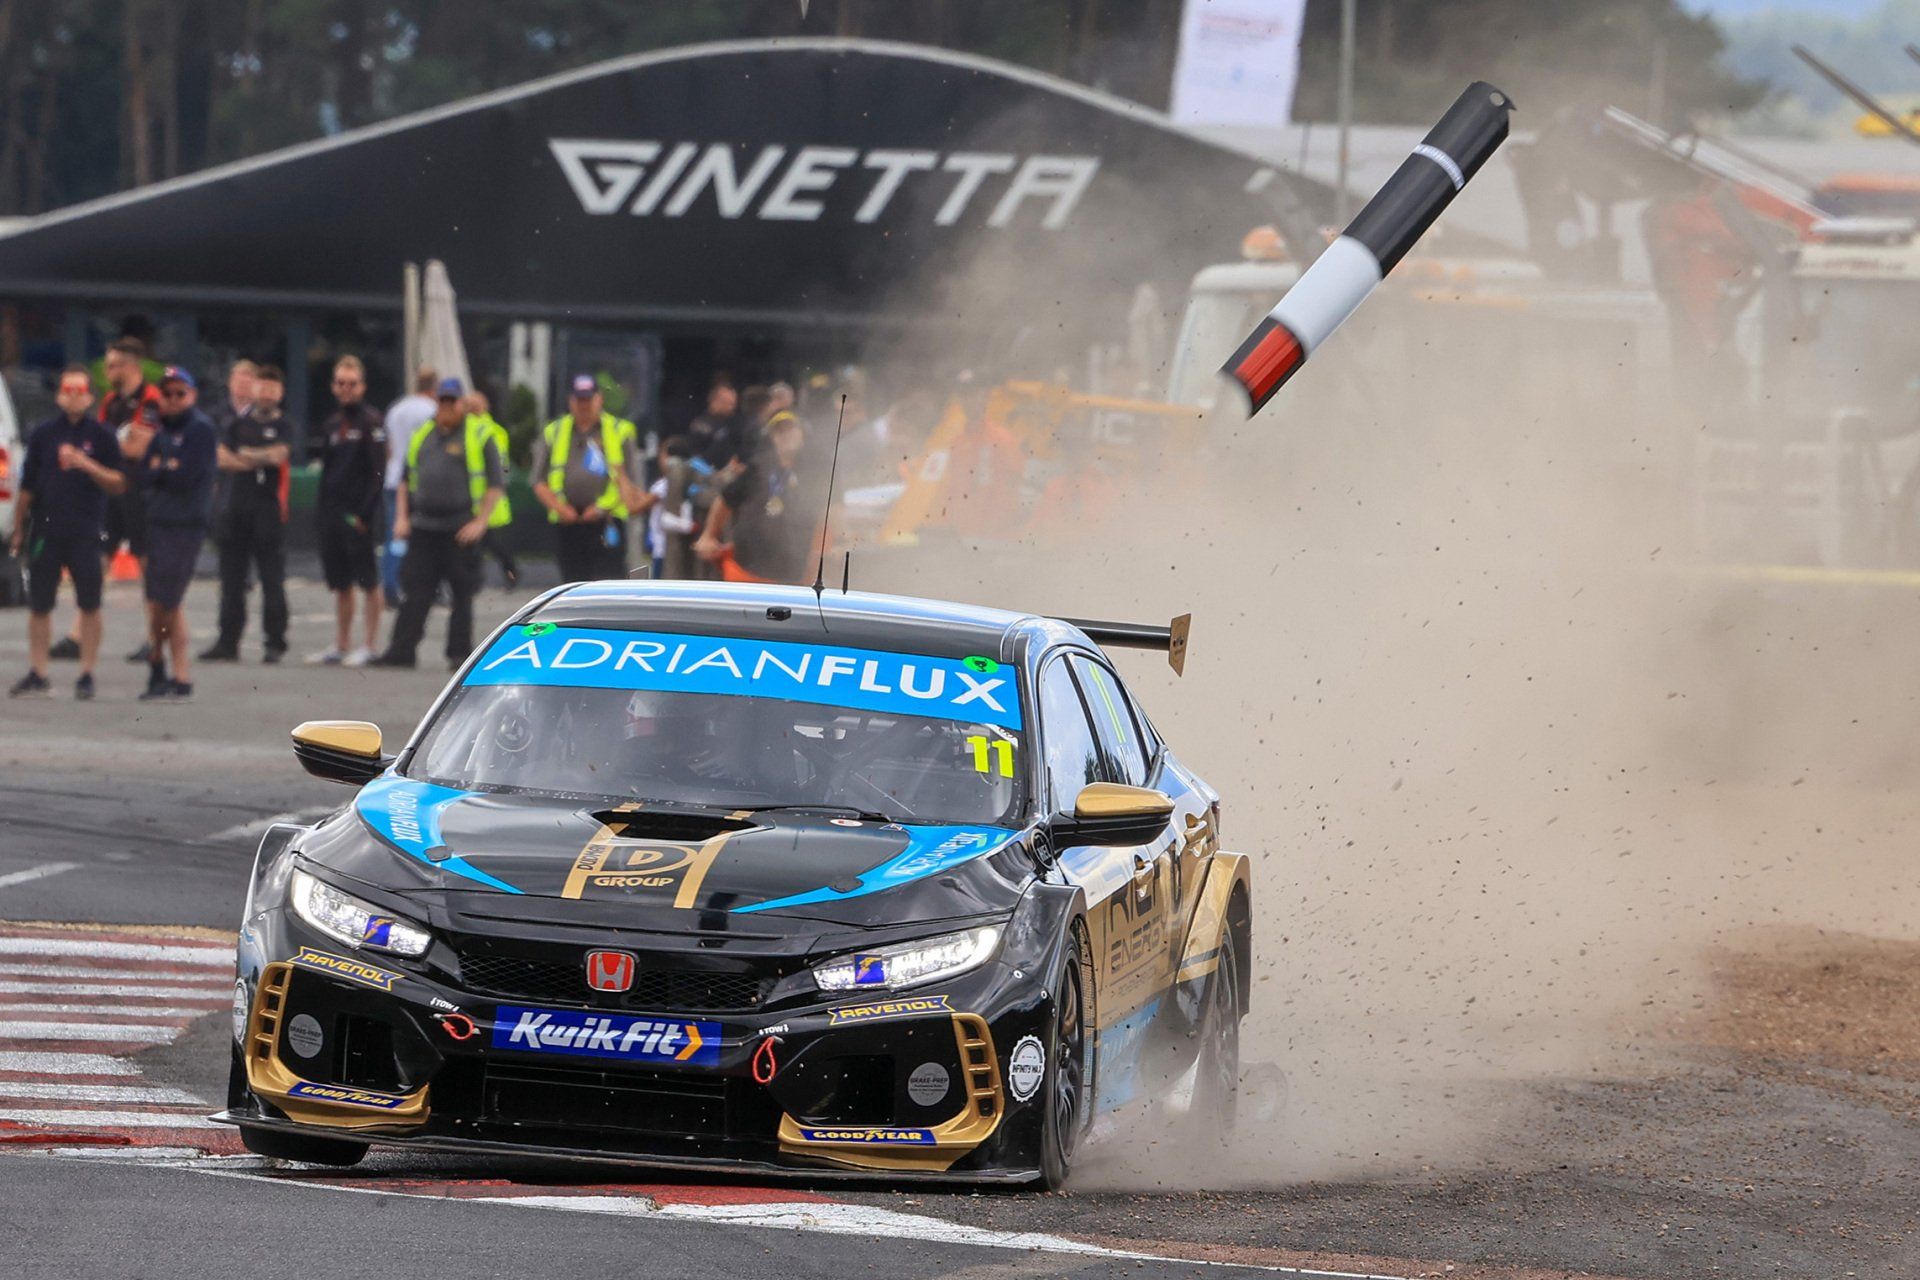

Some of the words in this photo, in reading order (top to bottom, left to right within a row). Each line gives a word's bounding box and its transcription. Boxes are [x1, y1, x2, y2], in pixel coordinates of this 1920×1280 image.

[548, 138, 1099, 230] GINETTA
[967, 734, 1014, 778] 11
[594, 876, 675, 887] GROUP
[302, 953, 391, 983] RAVENOL
[436, 1000, 453, 1010] TOW
[840, 1000, 941, 1019] RAVENOL
[764, 1025, 783, 1034] TOW
